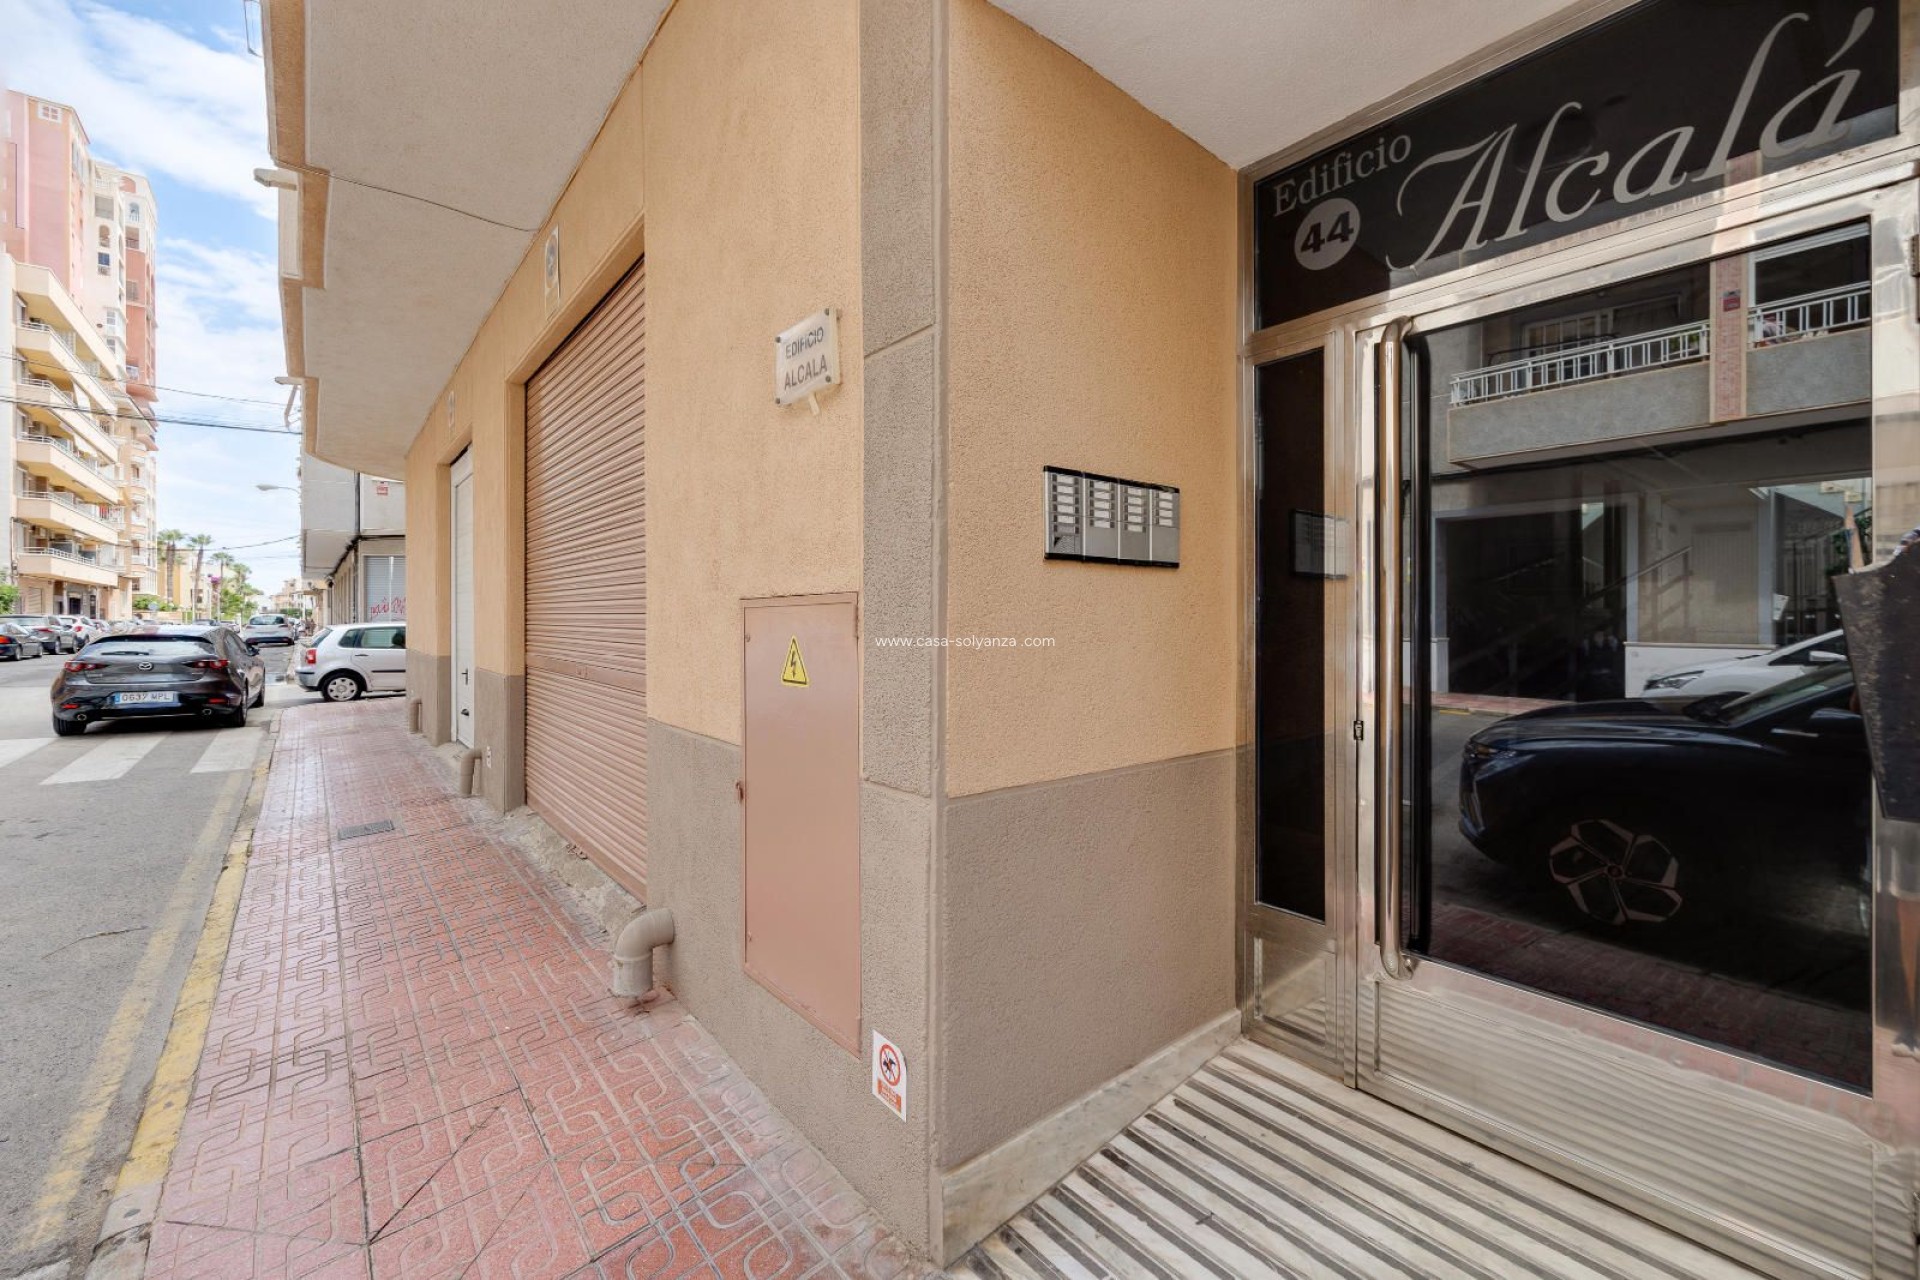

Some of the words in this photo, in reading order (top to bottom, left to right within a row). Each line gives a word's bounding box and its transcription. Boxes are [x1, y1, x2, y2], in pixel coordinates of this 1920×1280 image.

[1385, 6, 1875, 277] Alcalá
[1272, 133, 1412, 217] Edificio
[1299, 209, 1355, 254] 44
[785, 326, 824, 359] EDIFICIO
[784, 354, 828, 390] ALCALA
[151, 692, 170, 701] MPL
